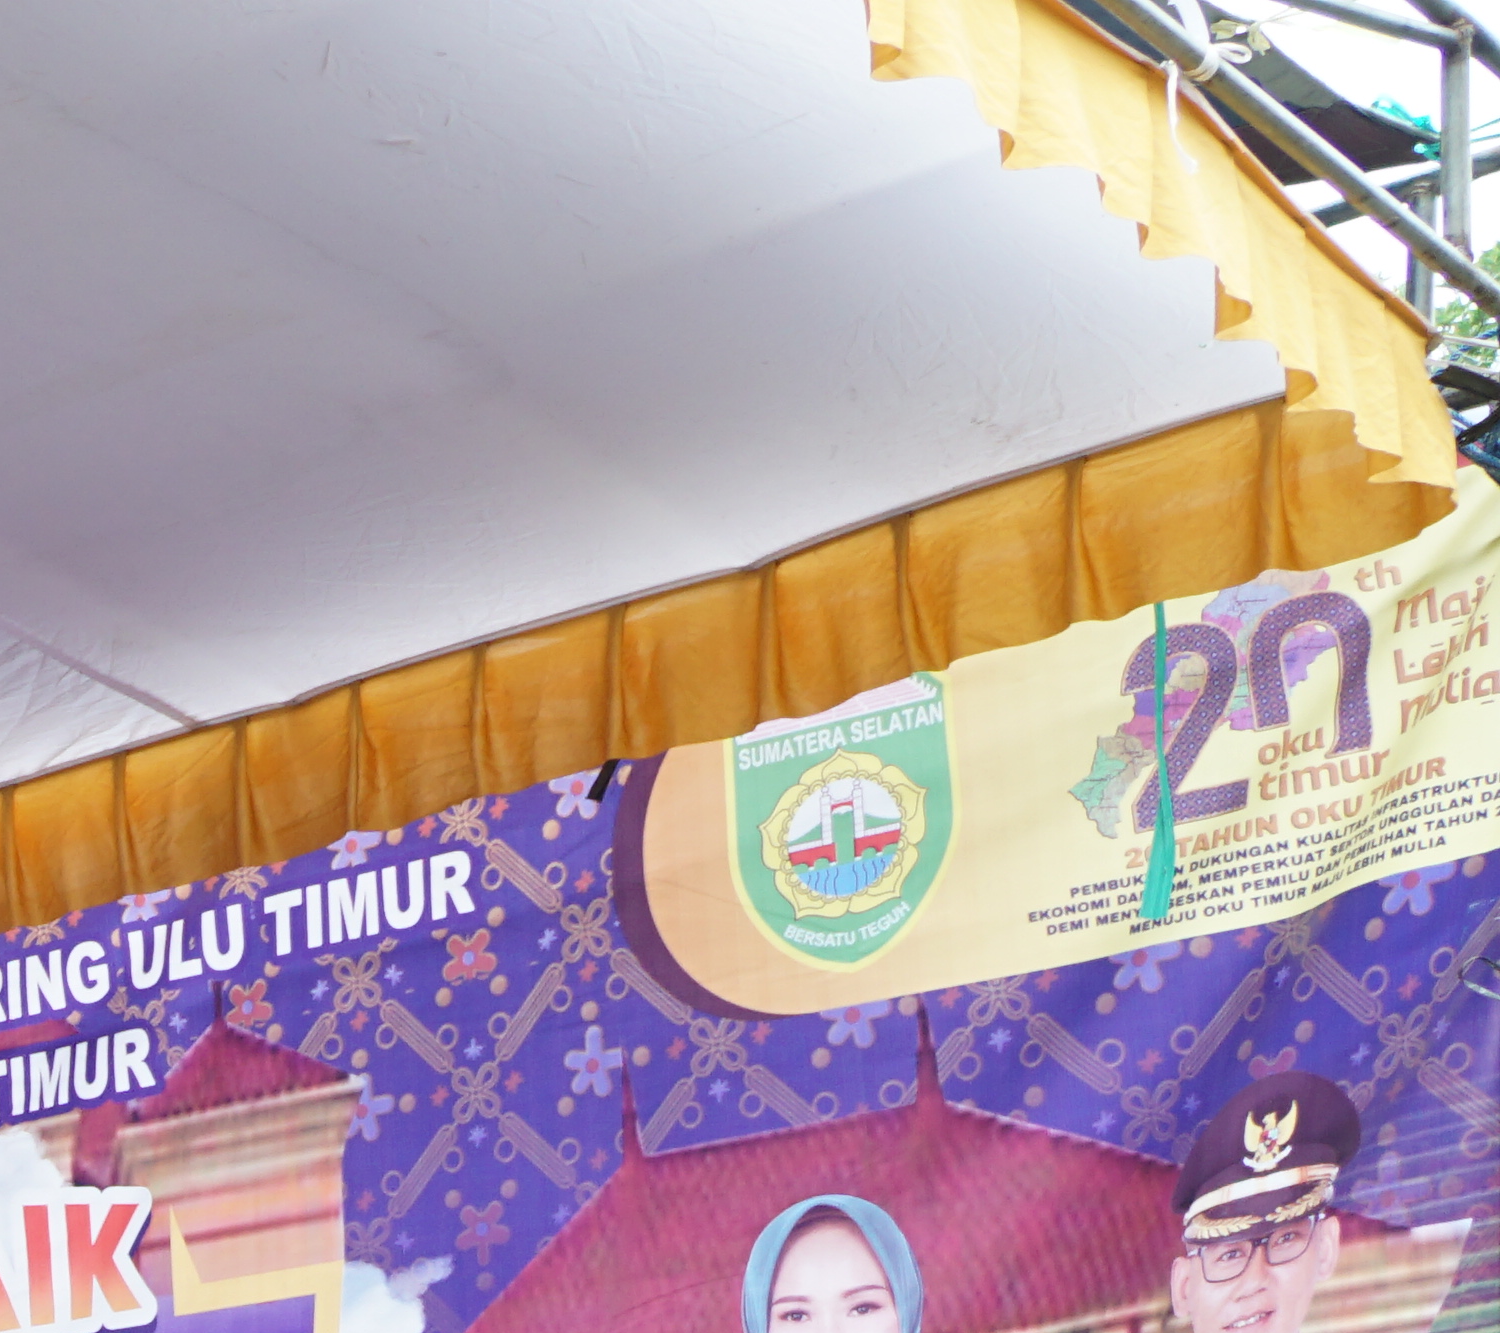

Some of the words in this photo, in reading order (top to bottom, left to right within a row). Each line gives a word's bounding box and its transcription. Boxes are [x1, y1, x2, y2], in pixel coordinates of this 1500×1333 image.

[739, 726, 847, 771] SUMATERA
[851, 701, 943, 743] SELATAN
[1258, 727, 1325, 766] oku
[1259, 748, 1390, 801] timur
[1175, 814, 1278, 858] TAHUN
[1291, 795, 1363, 830] OKU
[1371, 757, 1446, 807] TIMUR
[1190, 840, 1289, 873] DUKUNGAN
[1371, 771, 1500, 821] INFRASTRUKTU
[1028, 899, 1110, 923] EKONOMI
[1198, 849, 1326, 885] MEMPERKUAT
[1330, 826, 1375, 857] SEKTOR
[1379, 795, 1473, 830] UNGGULAN
[1047, 918, 1089, 936] DEMI
[1242, 870, 1310, 893] PEMILU
[1315, 860, 1341, 878] DAN
[1344, 824, 1417, 865] PEMILIHAN
[1425, 808, 1488, 832] TAHUN
[1129, 909, 1197, 936] MENUJU
[1203, 900, 1245, 918] OKU
[1253, 887, 1308, 908] TIMUR
[1311, 871, 1345, 894] MAJU
[1347, 854, 1386, 876] LEBIH
[1391, 836, 1447, 858] MULIA
[127, 903, 247, 990] ULU
[264, 850, 476, 956] TIMUR
[783, 924, 855, 948] BERSATU
[860, 901, 912, 940] TEGUH
